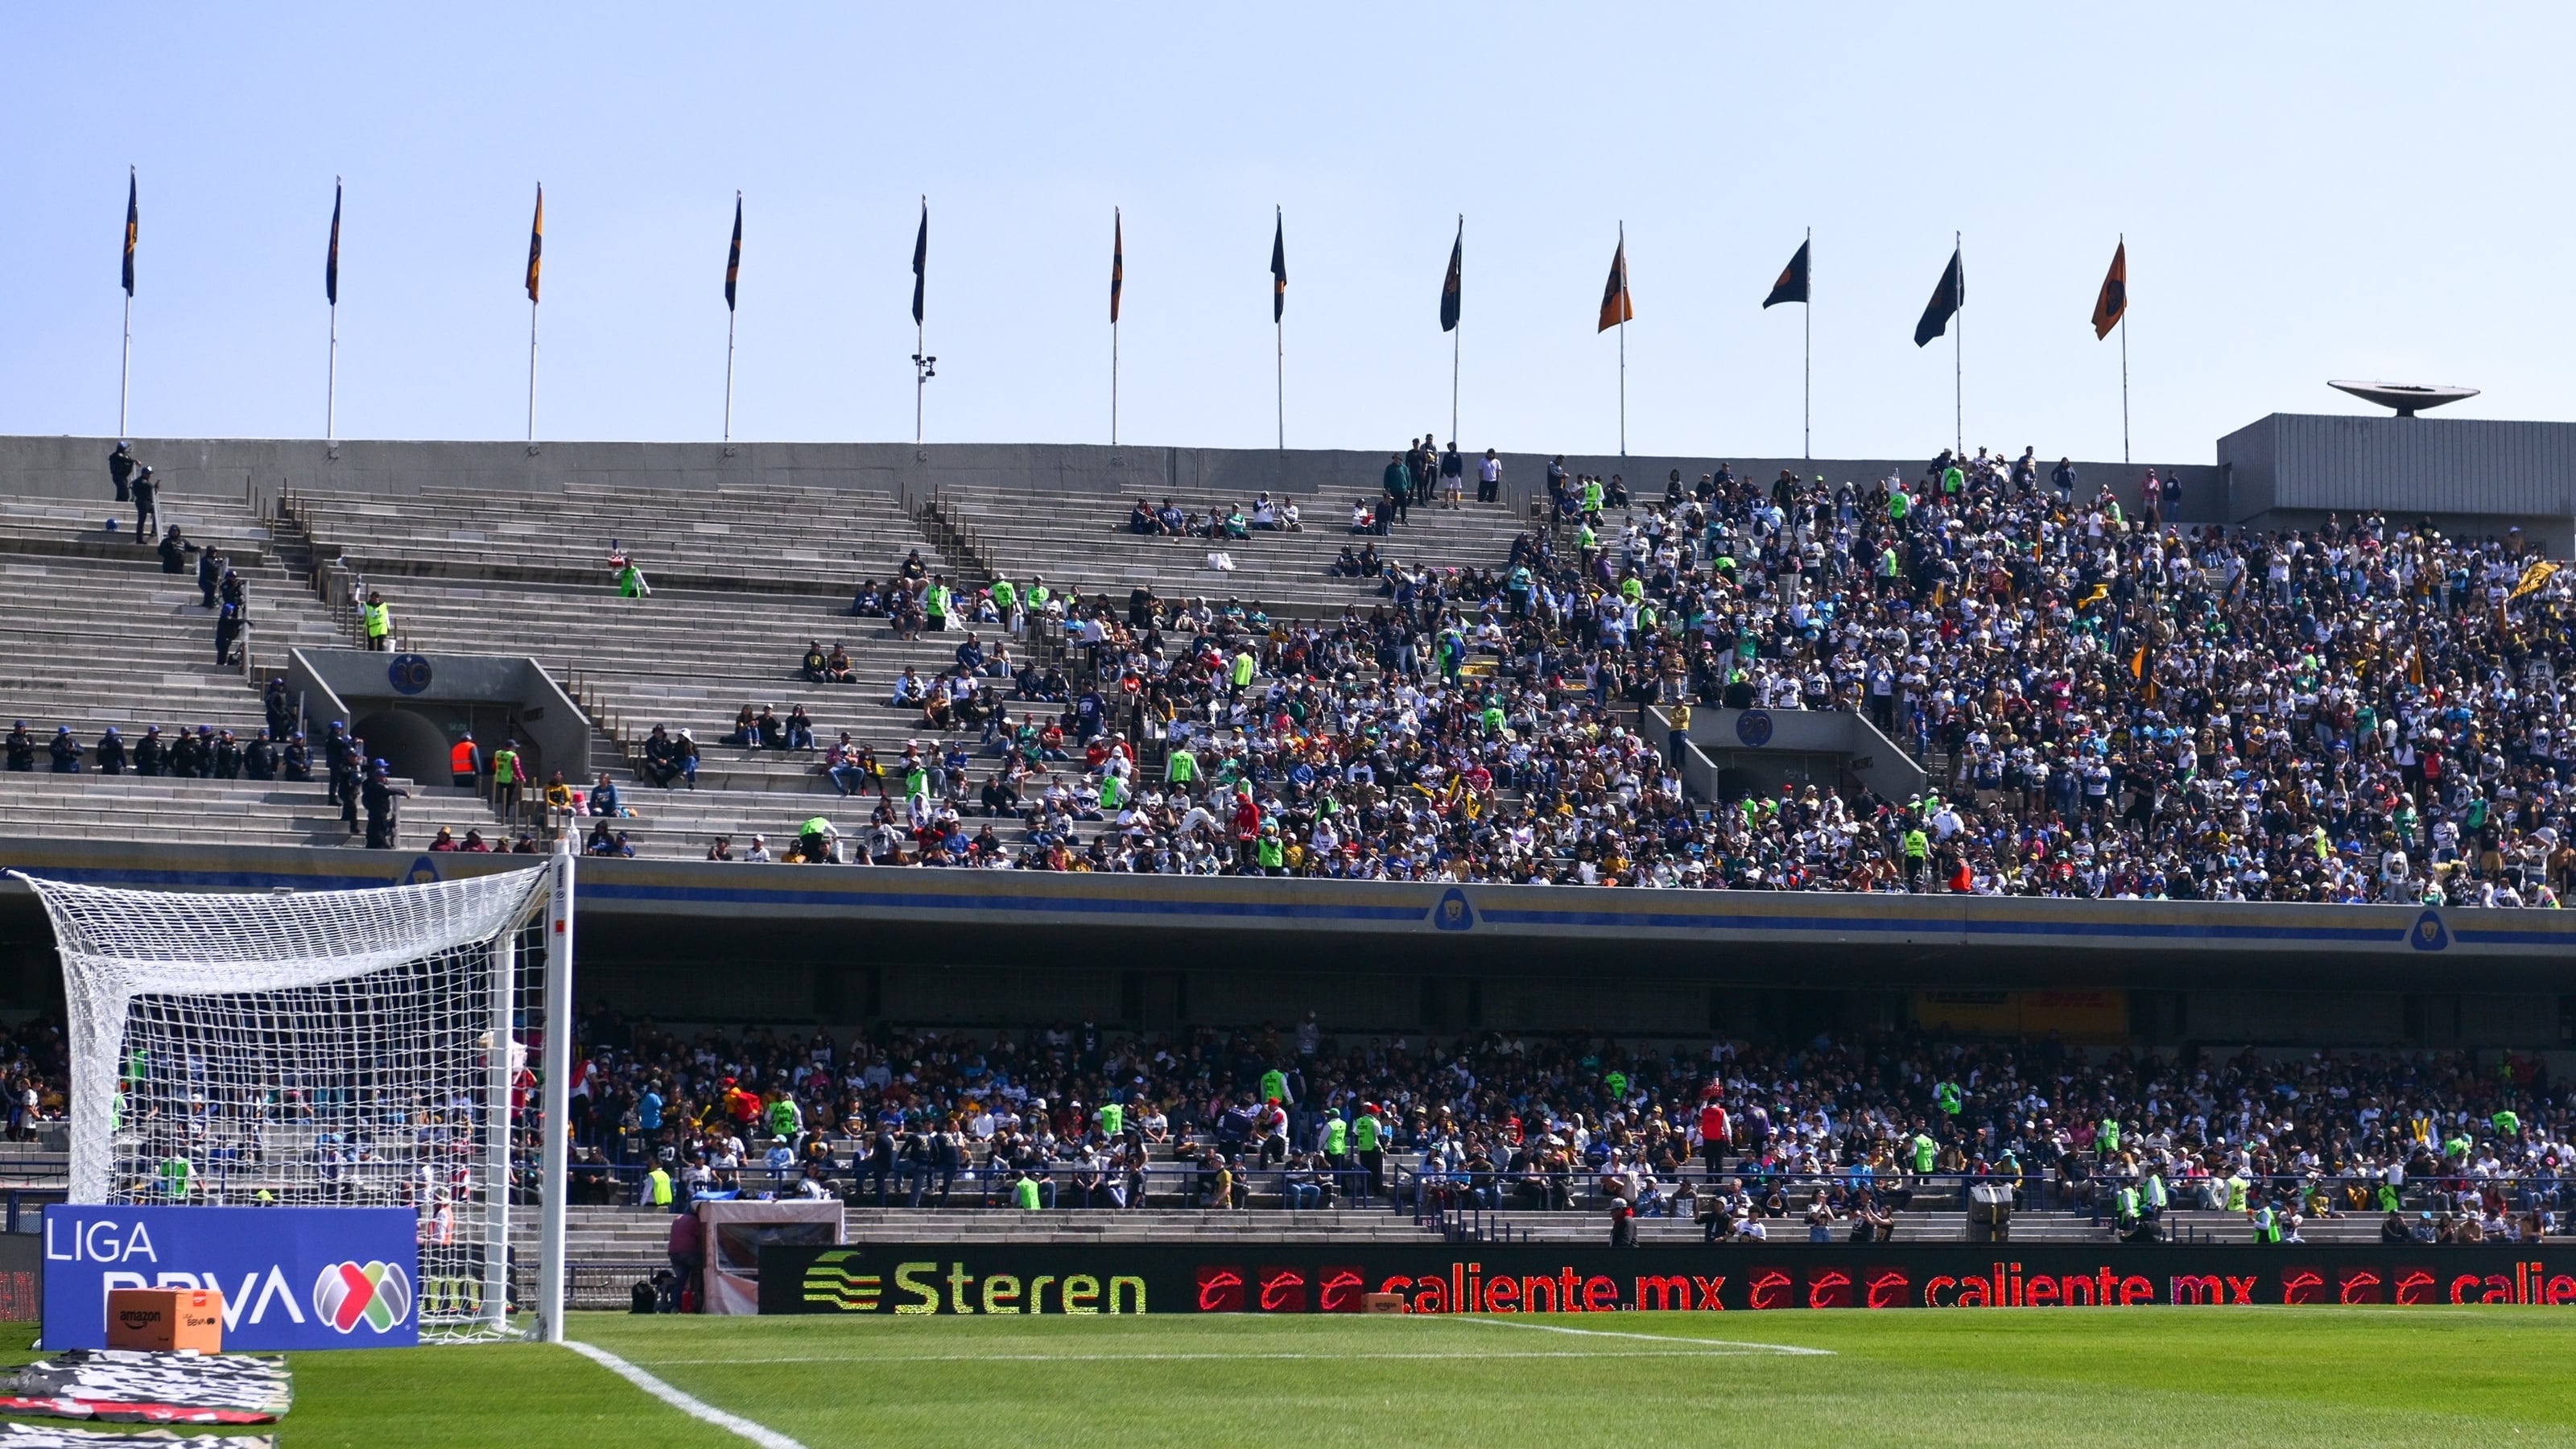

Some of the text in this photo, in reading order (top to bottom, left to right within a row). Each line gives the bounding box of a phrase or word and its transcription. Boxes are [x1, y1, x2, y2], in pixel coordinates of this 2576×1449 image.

[1741, 716, 1769, 739] 29
[658, 1146, 675, 1162] 20
[47, 1218, 158, 1262] LIGA
[894, 1261, 1146, 1314] Steren
[120, 1310, 161, 1322] amazon
